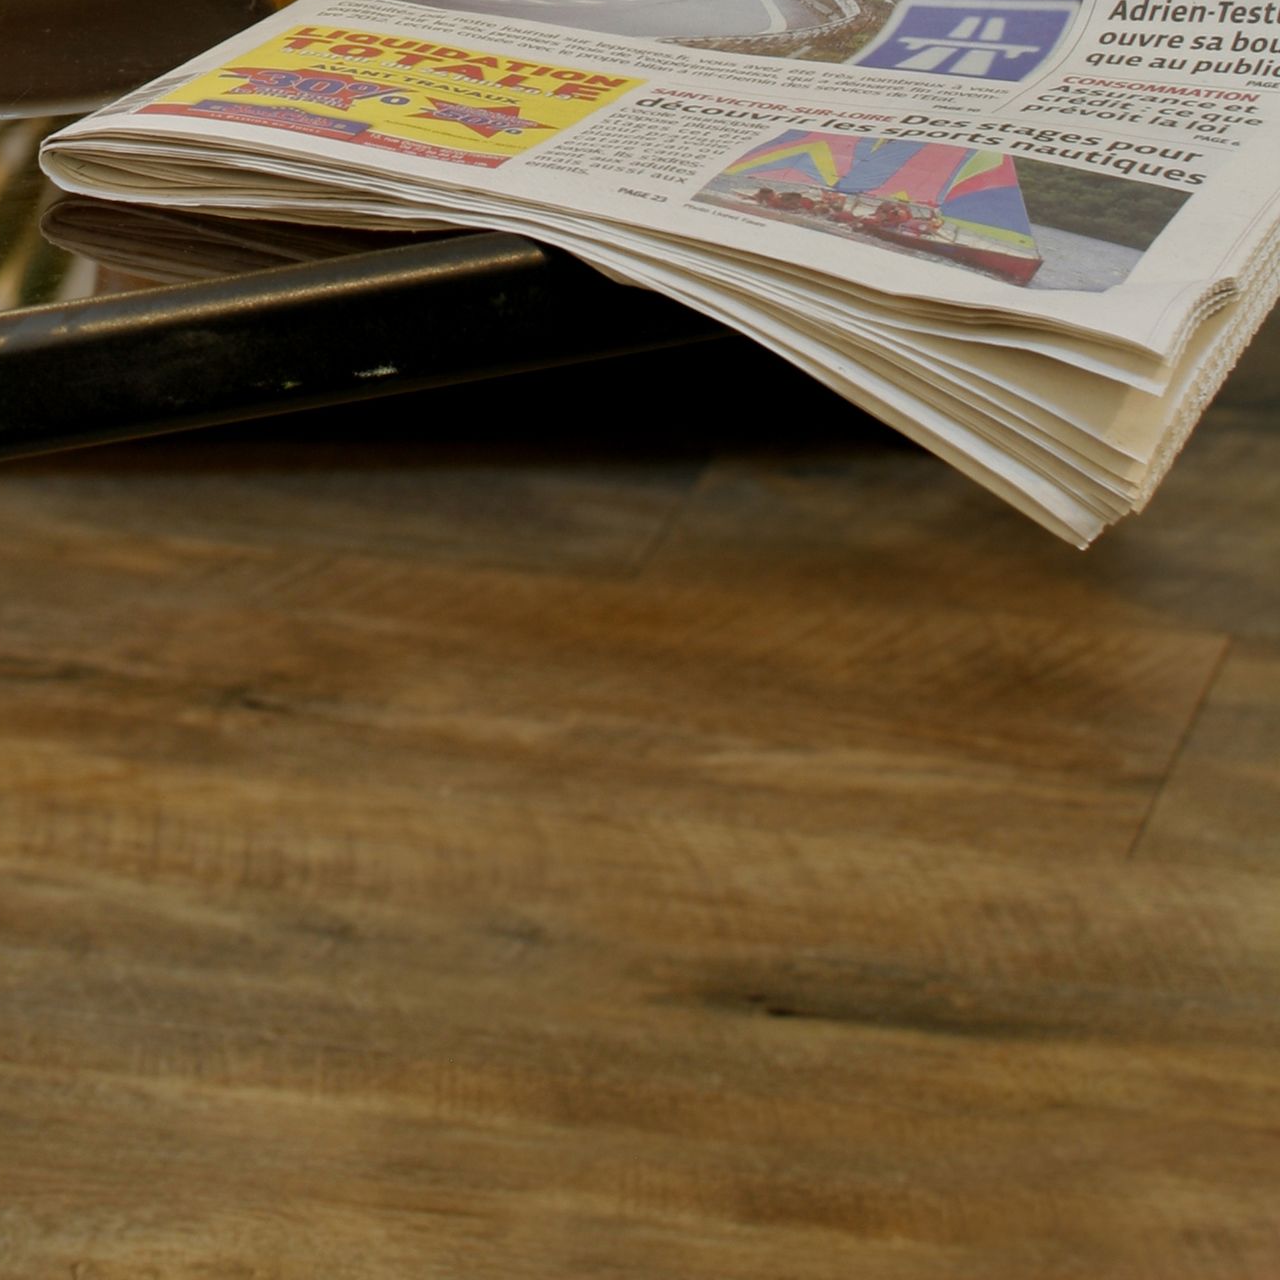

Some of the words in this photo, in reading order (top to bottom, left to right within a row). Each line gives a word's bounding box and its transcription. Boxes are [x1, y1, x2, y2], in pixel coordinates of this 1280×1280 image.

[1098, 31, 1185, 50] ouvre
[1189, 34, 1223, 51] sa
[283, 36, 613, 103] TOTALE
[292, 26, 630, 88] LIQUIDATION
[1085, 52, 1143, 67] que
[1148, 56, 1188, 71] au
[308, 63, 395, 79] AVANT
[403, 76, 521, 105] TRAVAUX
[1062, 75, 1262, 104] CONSOMMATION
[1245, 79, 1280, 90] PAGE
[1036, 93, 1137, 112] crédit
[1158, 106, 1195, 119] ce
[1200, 111, 1264, 127] que
[1048, 85, 1217, 110] Assurance
[1223, 101, 1260, 115] et
[650, 86, 898, 123] SAINT-VICTOR-SUR-LOIRE
[898, 113, 973, 129] Des
[980, 120, 1103, 148] stages
[1104, 138, 1206, 164] pour
[1019, 102, 1145, 124] prévoit
[1147, 115, 1178, 130] la
[1185, 120, 1233, 135] loi
[634, 96, 817, 126] découvrir
[820, 119, 878, 135] les
[879, 124, 1006, 147] sports
[1008, 140, 1209, 186] nautiques
[1193, 134, 1230, 146] PAGE
[617, 187, 650, 200] PAGE
